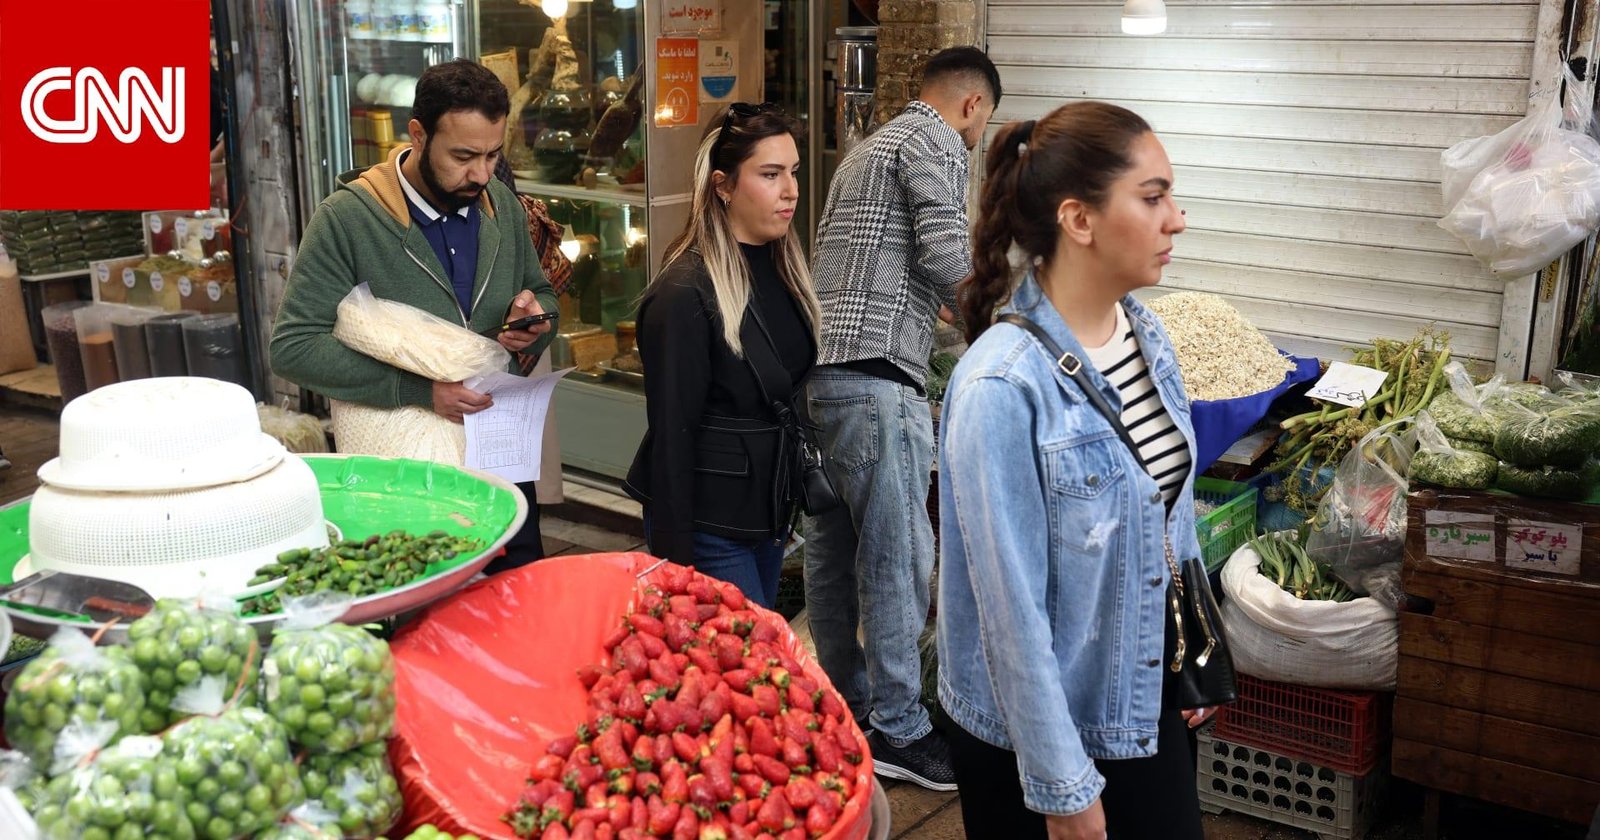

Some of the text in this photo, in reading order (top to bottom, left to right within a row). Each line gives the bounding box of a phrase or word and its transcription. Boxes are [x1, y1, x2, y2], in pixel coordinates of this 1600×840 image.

[669, 5, 686, 17] است
[659, 48, 696, 57] لطفا با ماسک
[680, 71, 693, 82] وارد
[1462, 533, 1490, 546] سیر
[1521, 549, 1558, 567] با سیر
